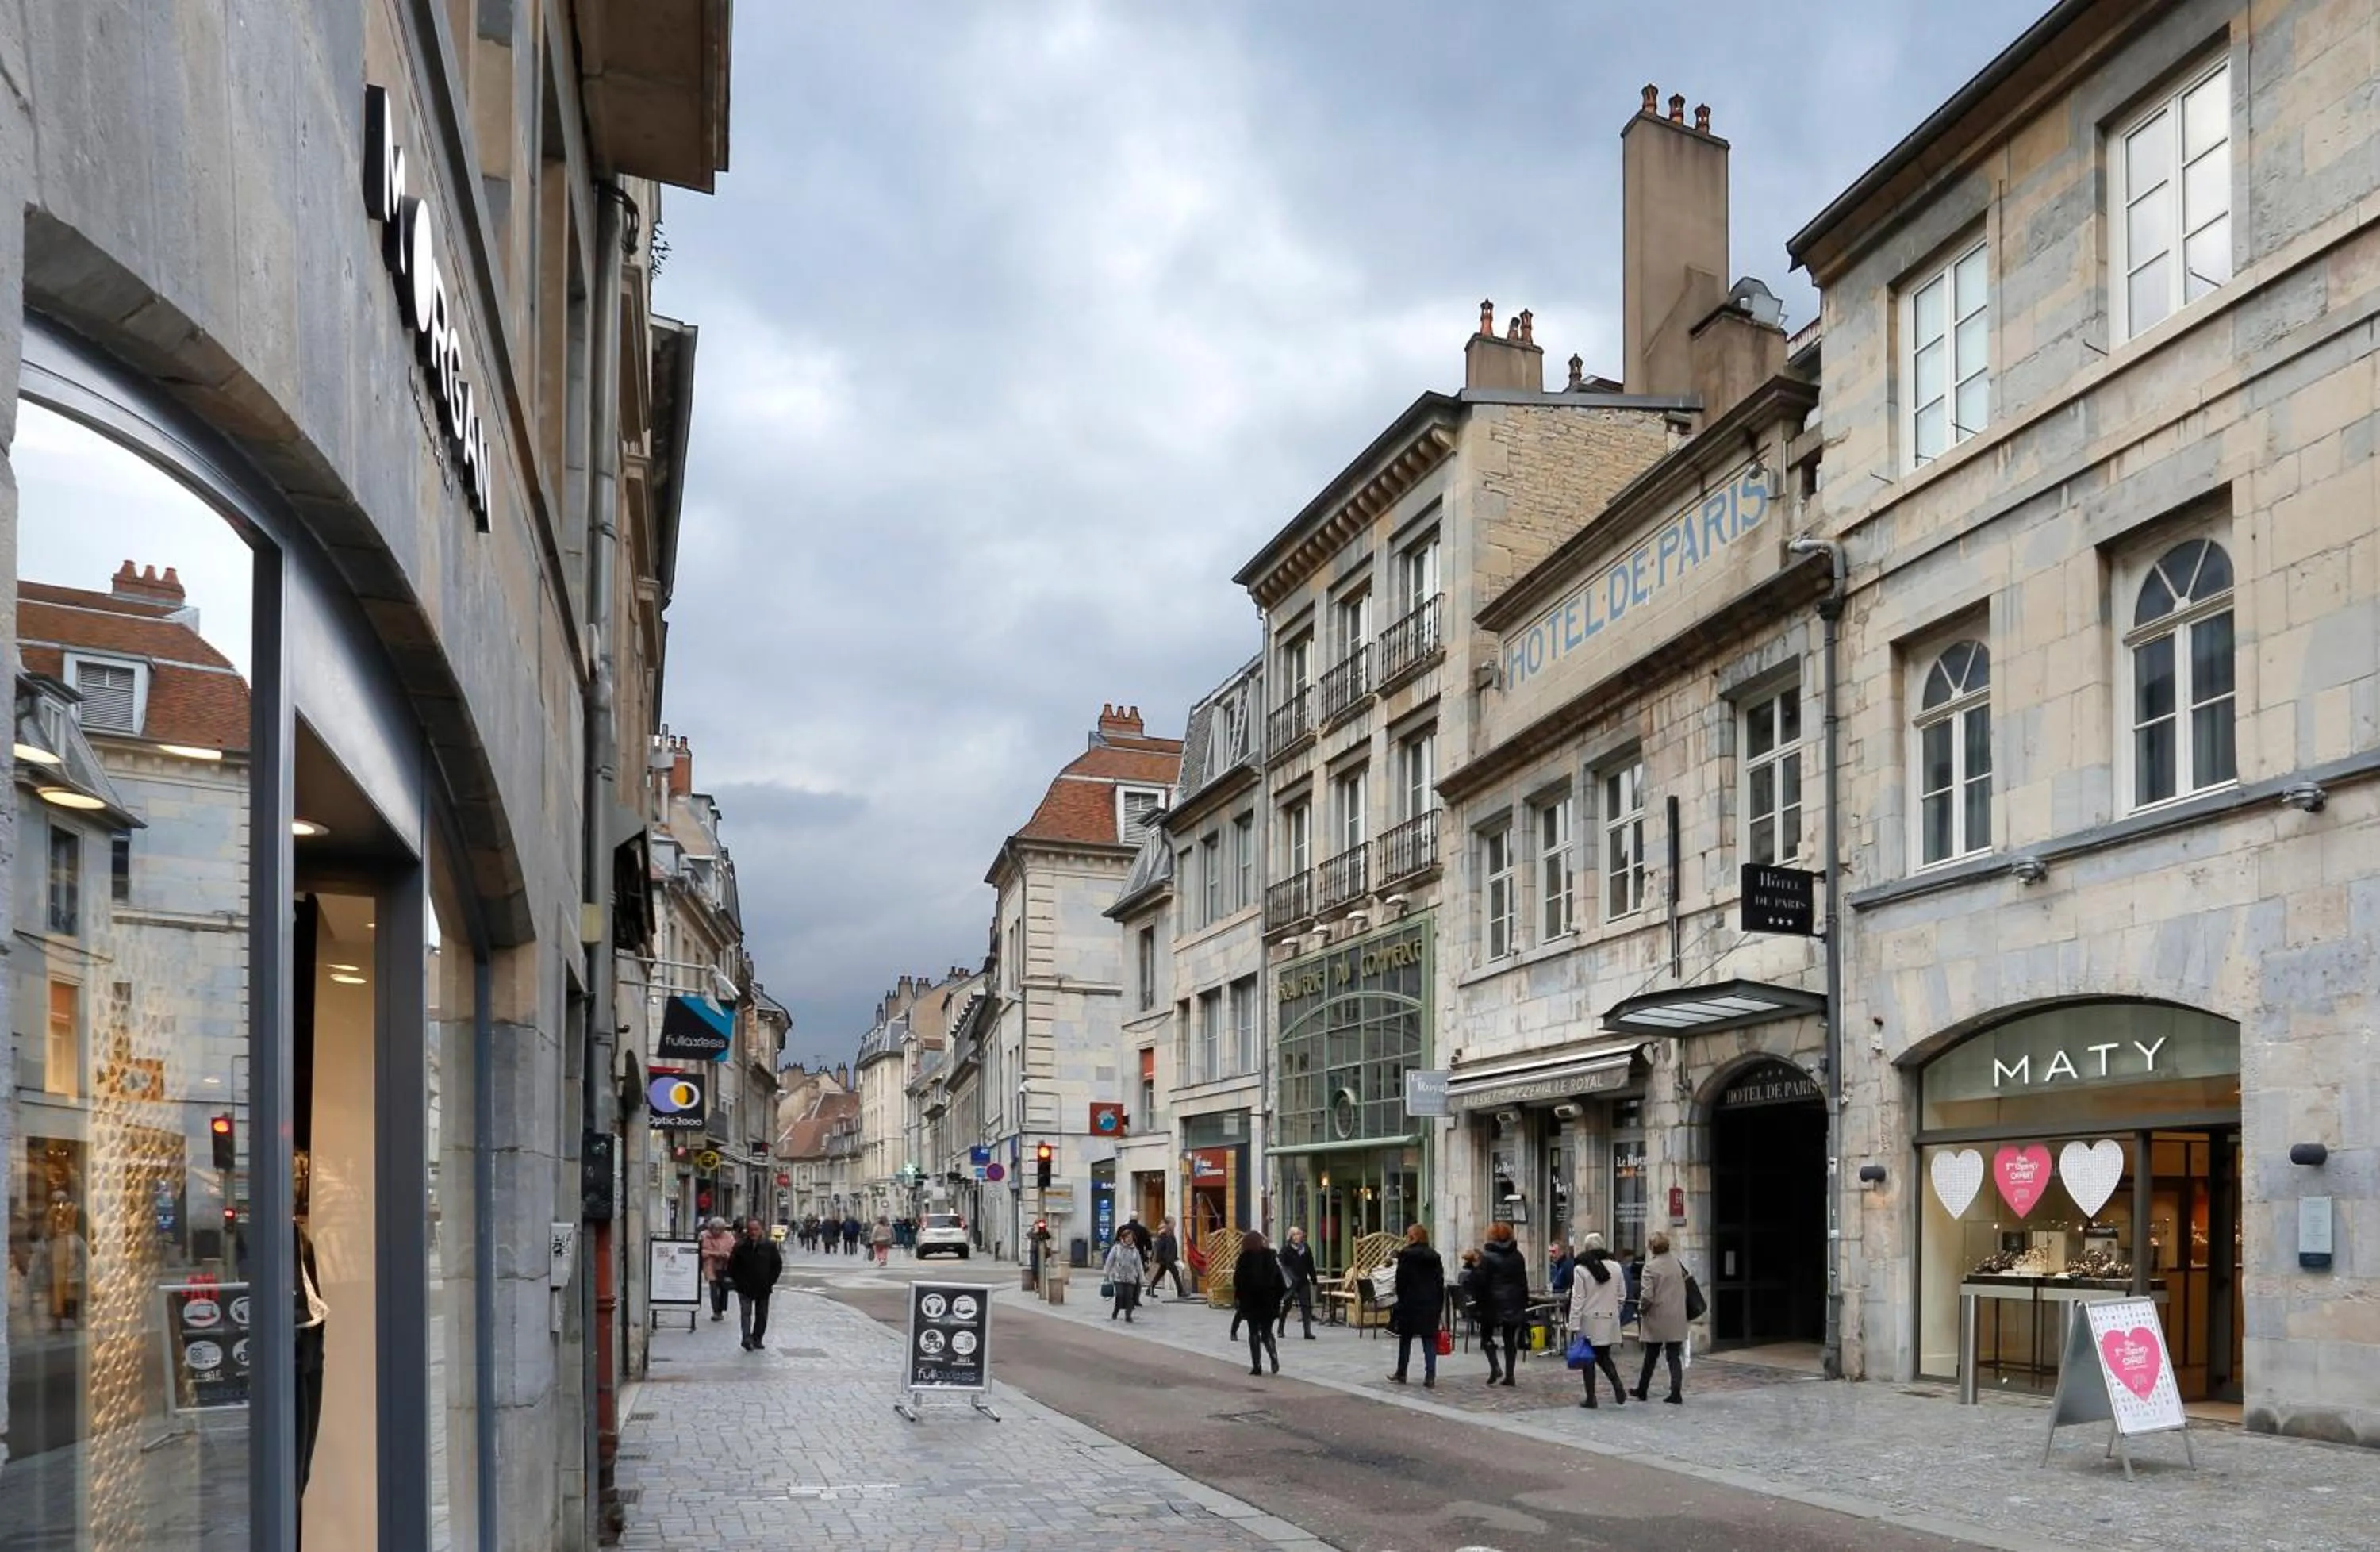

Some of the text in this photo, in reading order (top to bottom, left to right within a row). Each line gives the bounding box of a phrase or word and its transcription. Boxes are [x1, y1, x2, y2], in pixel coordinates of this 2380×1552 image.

[367, 84, 493, 534] MORGAN
[1657, 473, 1769, 589] PARIS
[1756, 895, 1767, 906] DE
[1993, 1036, 2167, 1088] MATY
[1570, 1073, 1603, 1092] ROYAL
[1767, 1083, 1783, 1099] DE
[1784, 1078, 1818, 1097] PARIS
[648, 1116, 703, 1127] Optic 2000
